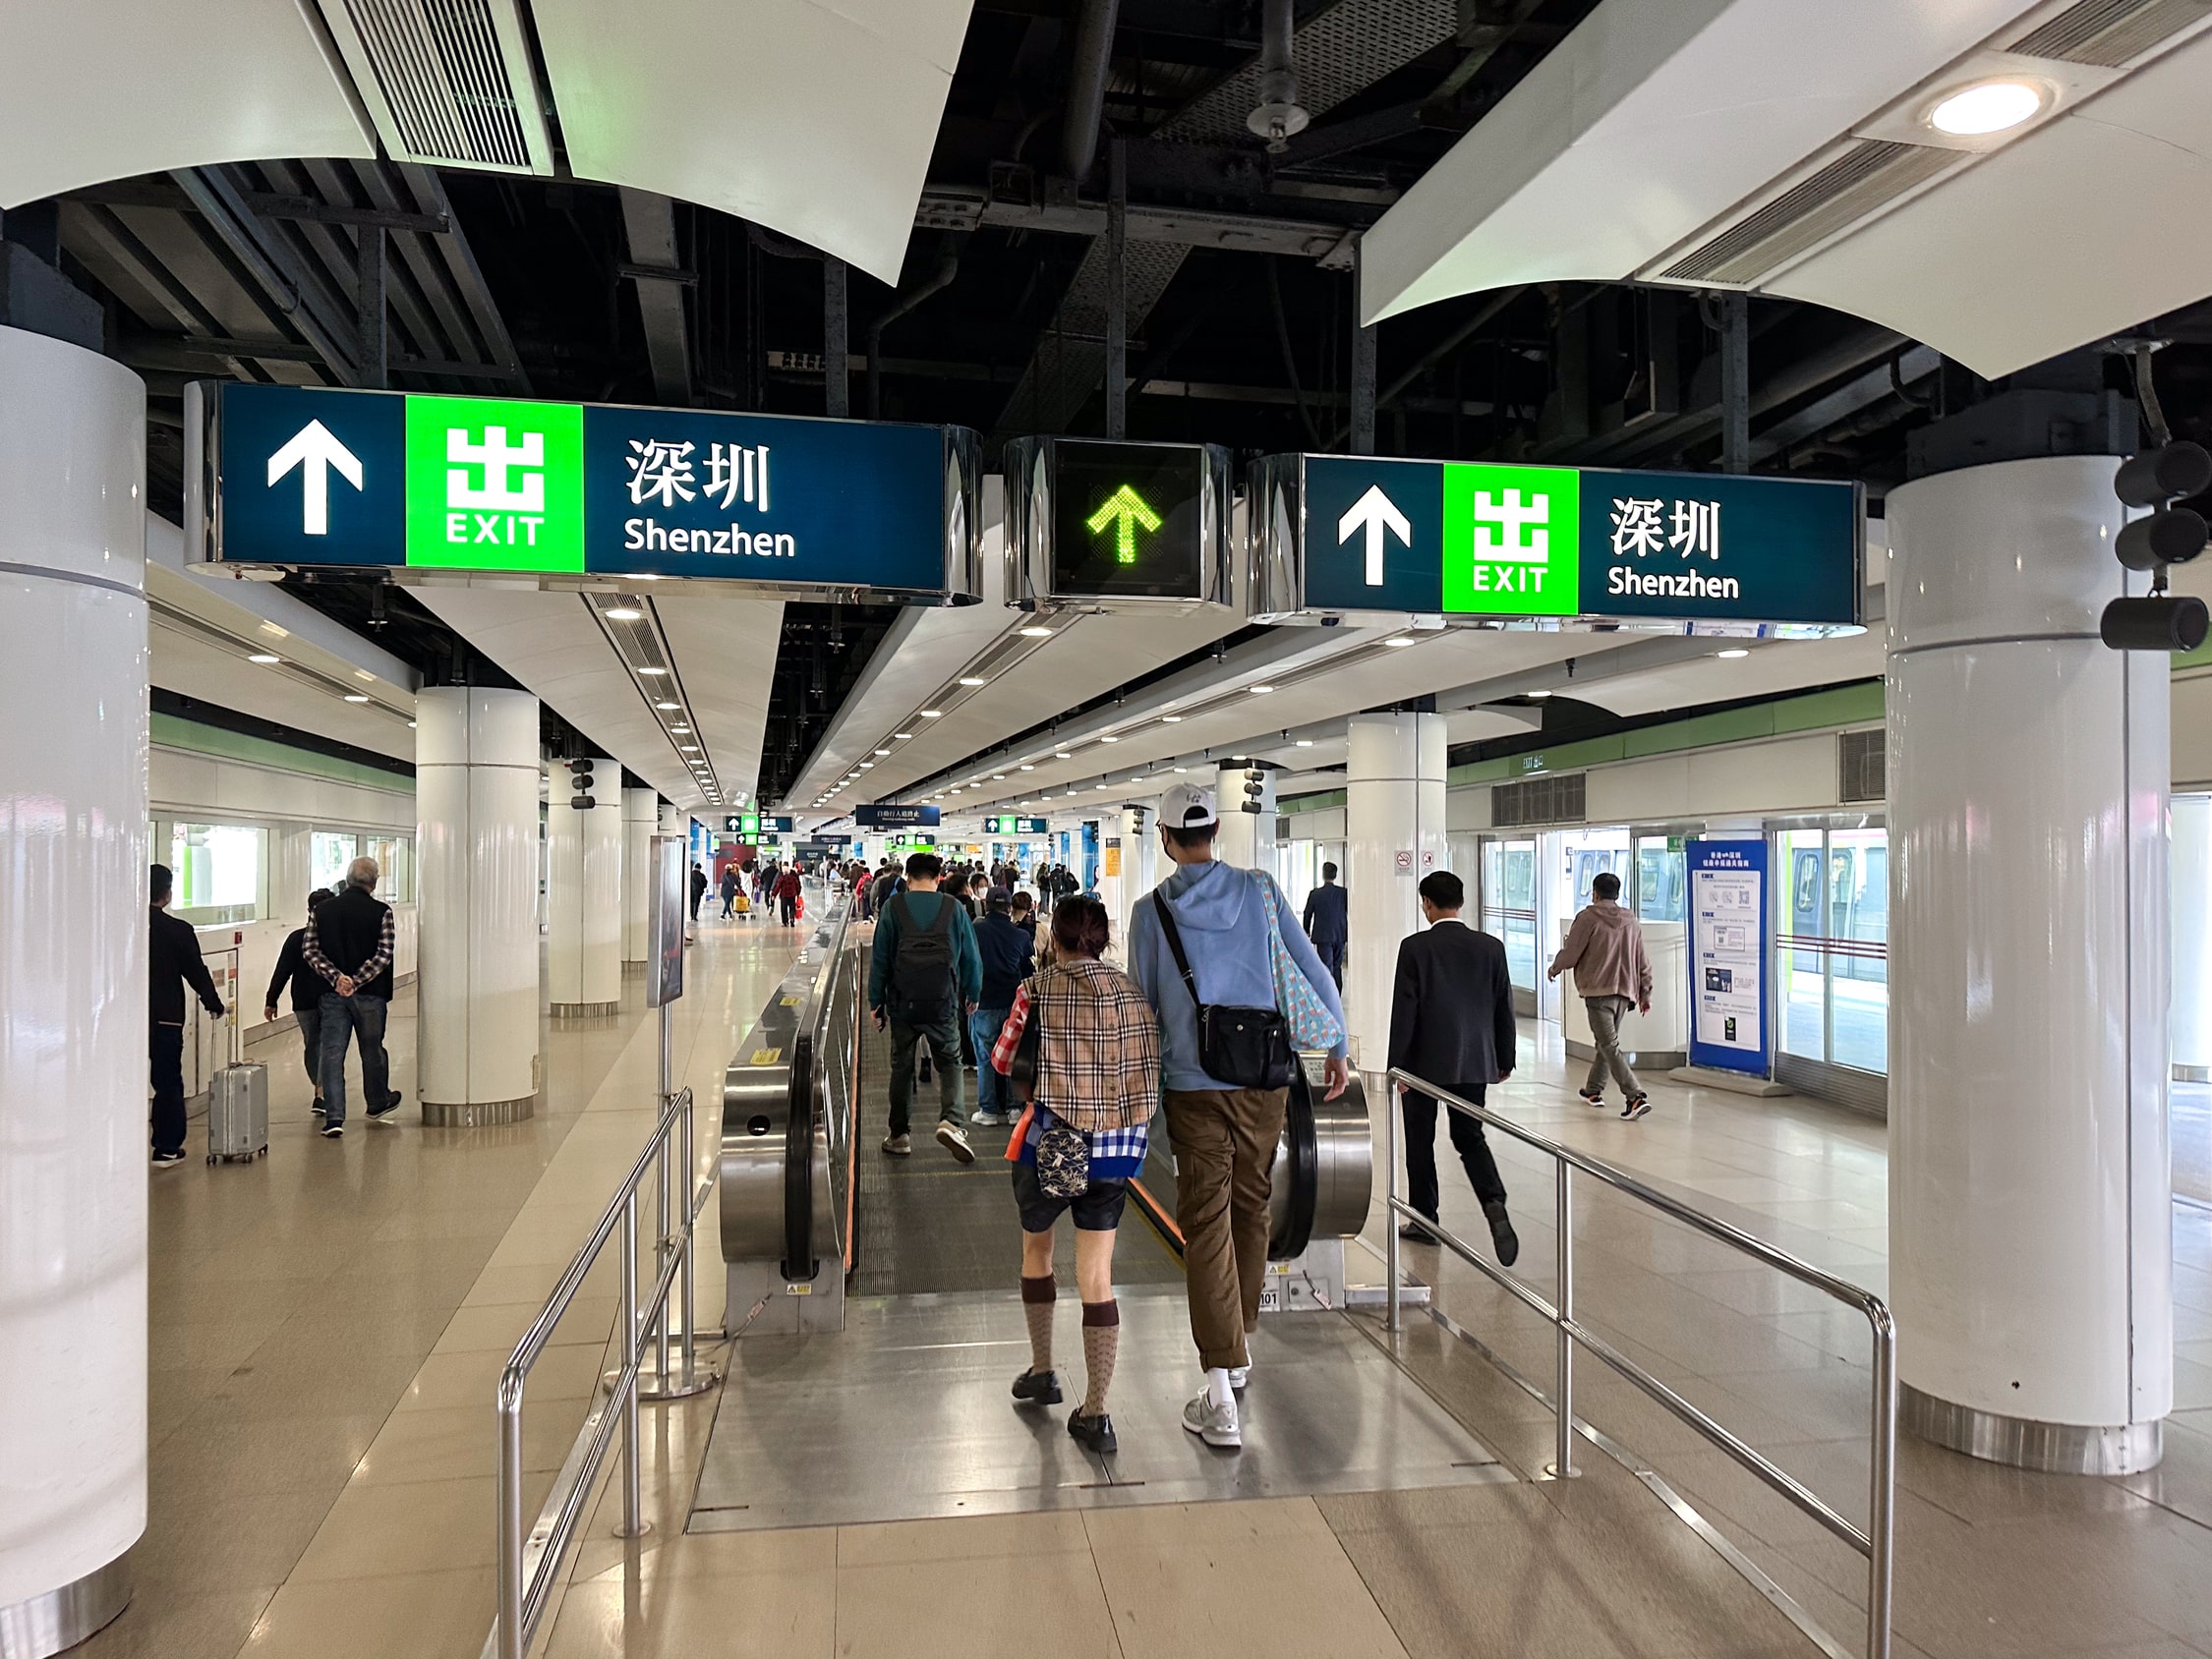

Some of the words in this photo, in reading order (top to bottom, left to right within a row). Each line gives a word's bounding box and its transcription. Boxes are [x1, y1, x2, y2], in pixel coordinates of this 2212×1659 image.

[446, 426, 545, 512] 出
[625, 438, 770, 512] 深圳
[446, 513, 545, 546] EXIT
[624, 518, 795, 557] Shenzhen
[1474, 488, 1549, 563] 出
[1609, 496, 1721, 560] 深圳
[1473, 565, 1548, 593] EXIT
[1607, 566, 1739, 599] Shenzhen
